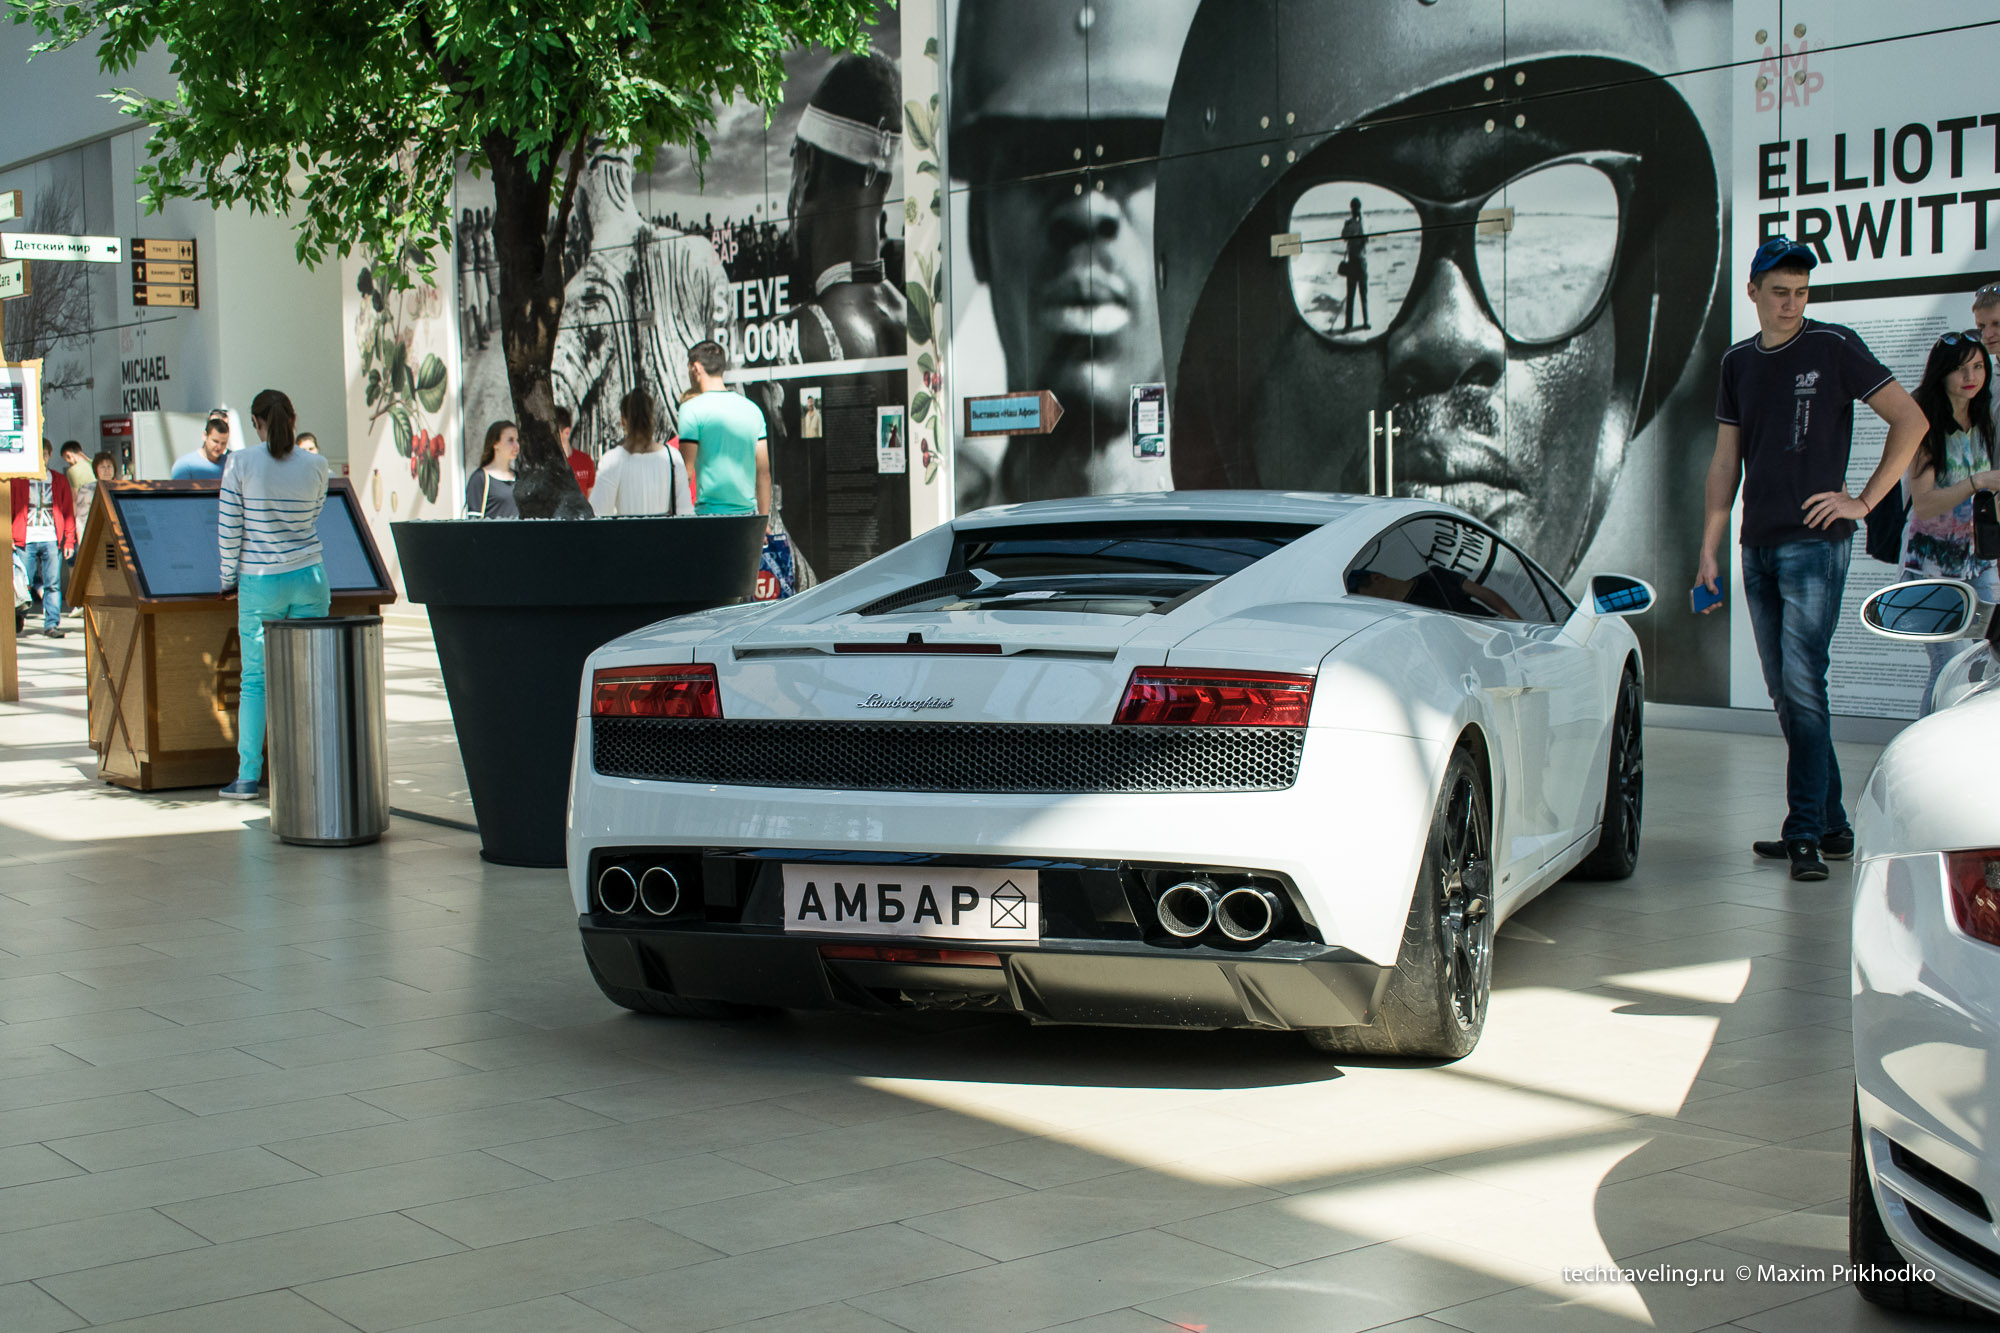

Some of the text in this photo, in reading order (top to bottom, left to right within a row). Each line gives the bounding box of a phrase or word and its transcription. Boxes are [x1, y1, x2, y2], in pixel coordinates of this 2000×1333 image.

[14, 240, 91, 254] Детский мир
[712, 275, 791, 322] STEVE
[713, 319, 800, 363] BLOOM
[121, 355, 170, 385] MICHAEL
[122, 386, 161, 413] KENNA
[972, 410, 1000, 419] Выставка
[856, 692, 955, 712] Lamborghini
[797, 881, 980, 926] АМБАР
